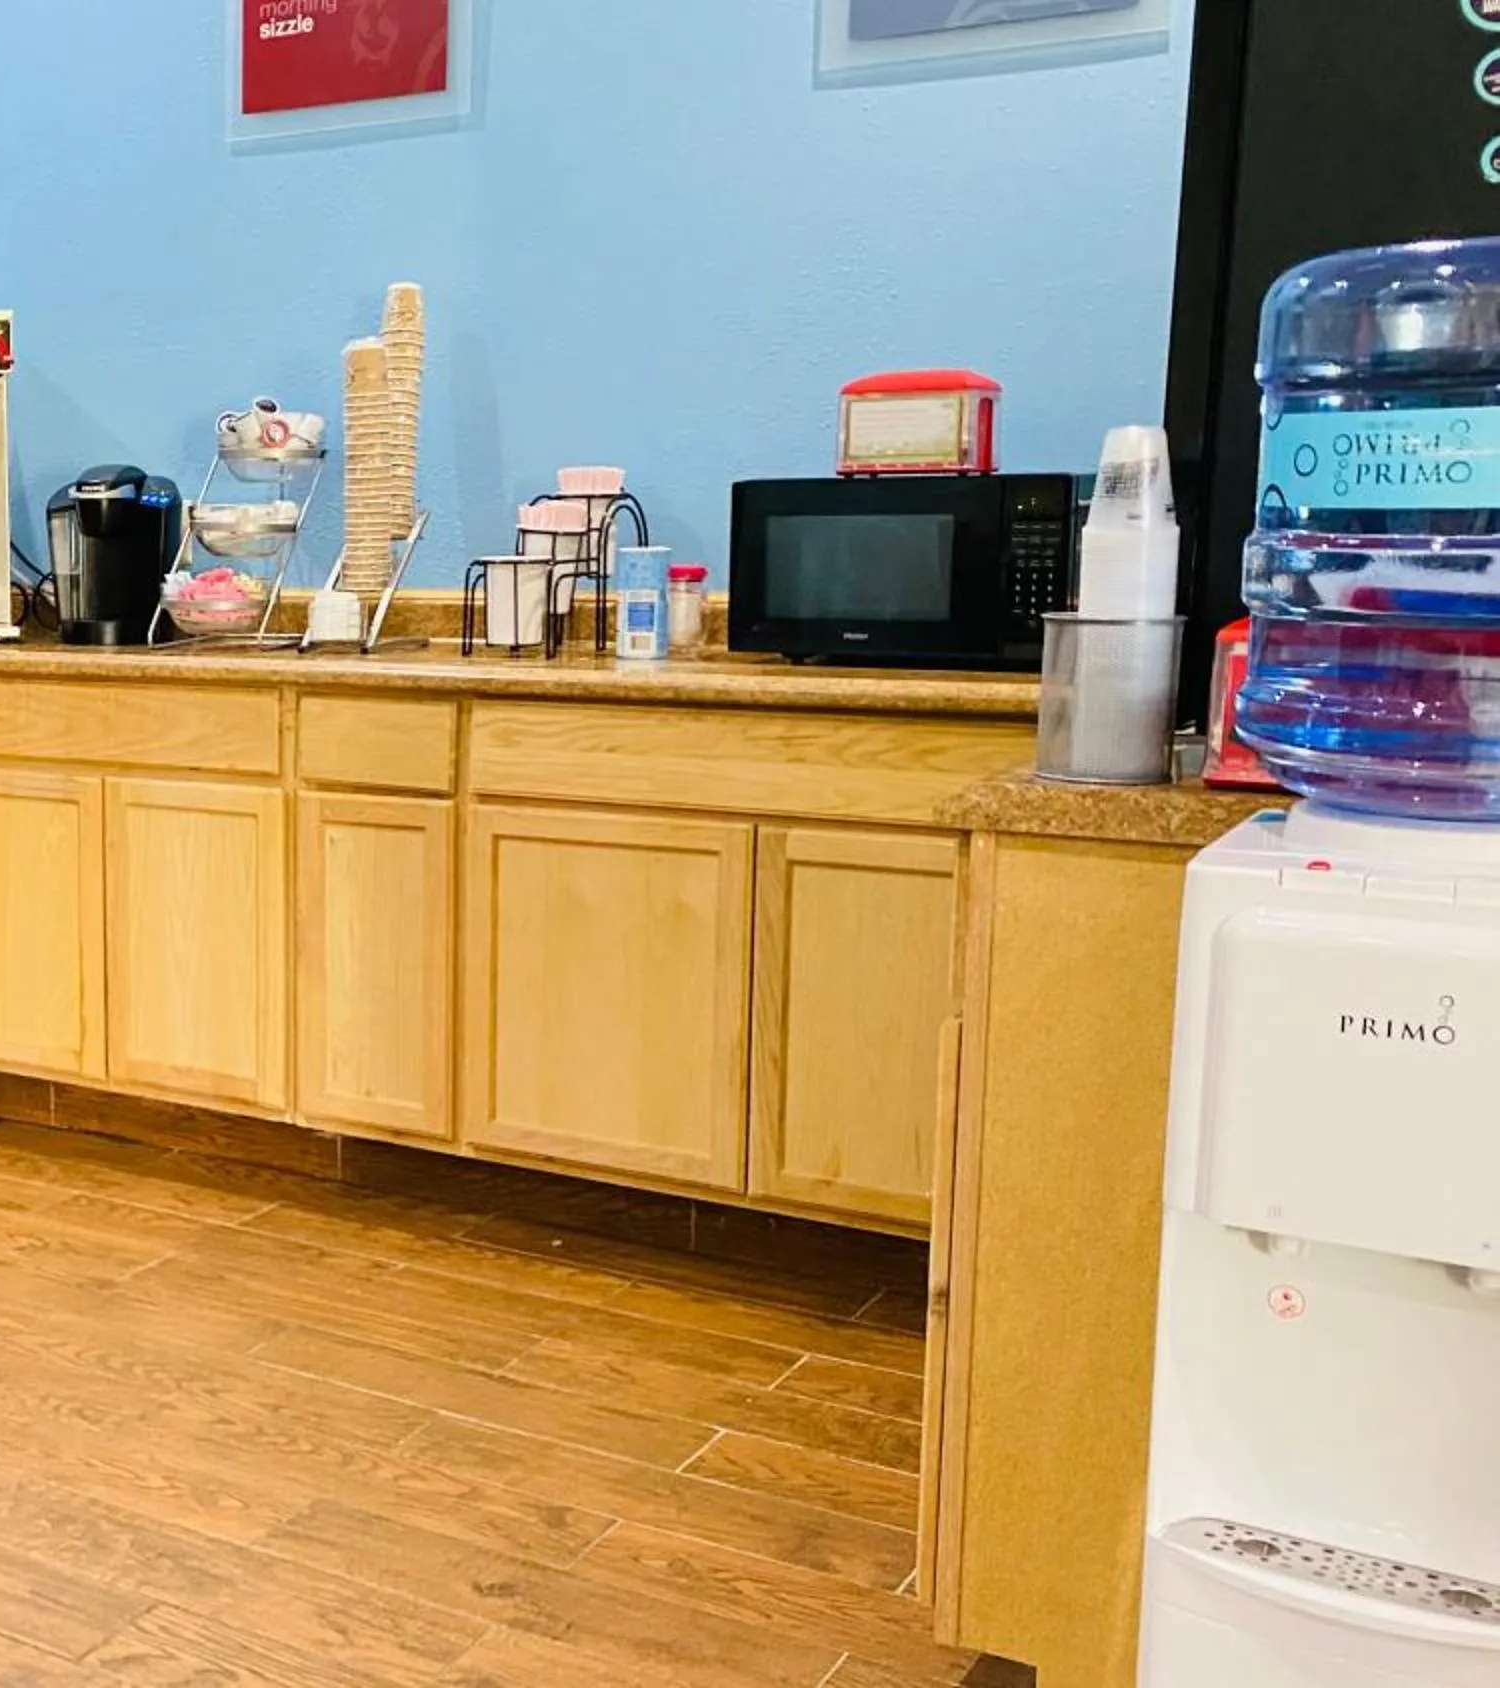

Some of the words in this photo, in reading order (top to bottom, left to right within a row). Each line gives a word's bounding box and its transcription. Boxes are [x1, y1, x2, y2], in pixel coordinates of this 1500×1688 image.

[260, 0, 337, 18] morning
[259, 13, 315, 39] sizzle
[1355, 460, 1473, 485] PRIMO
[1340, 1015, 1456, 1046] PRIMO
